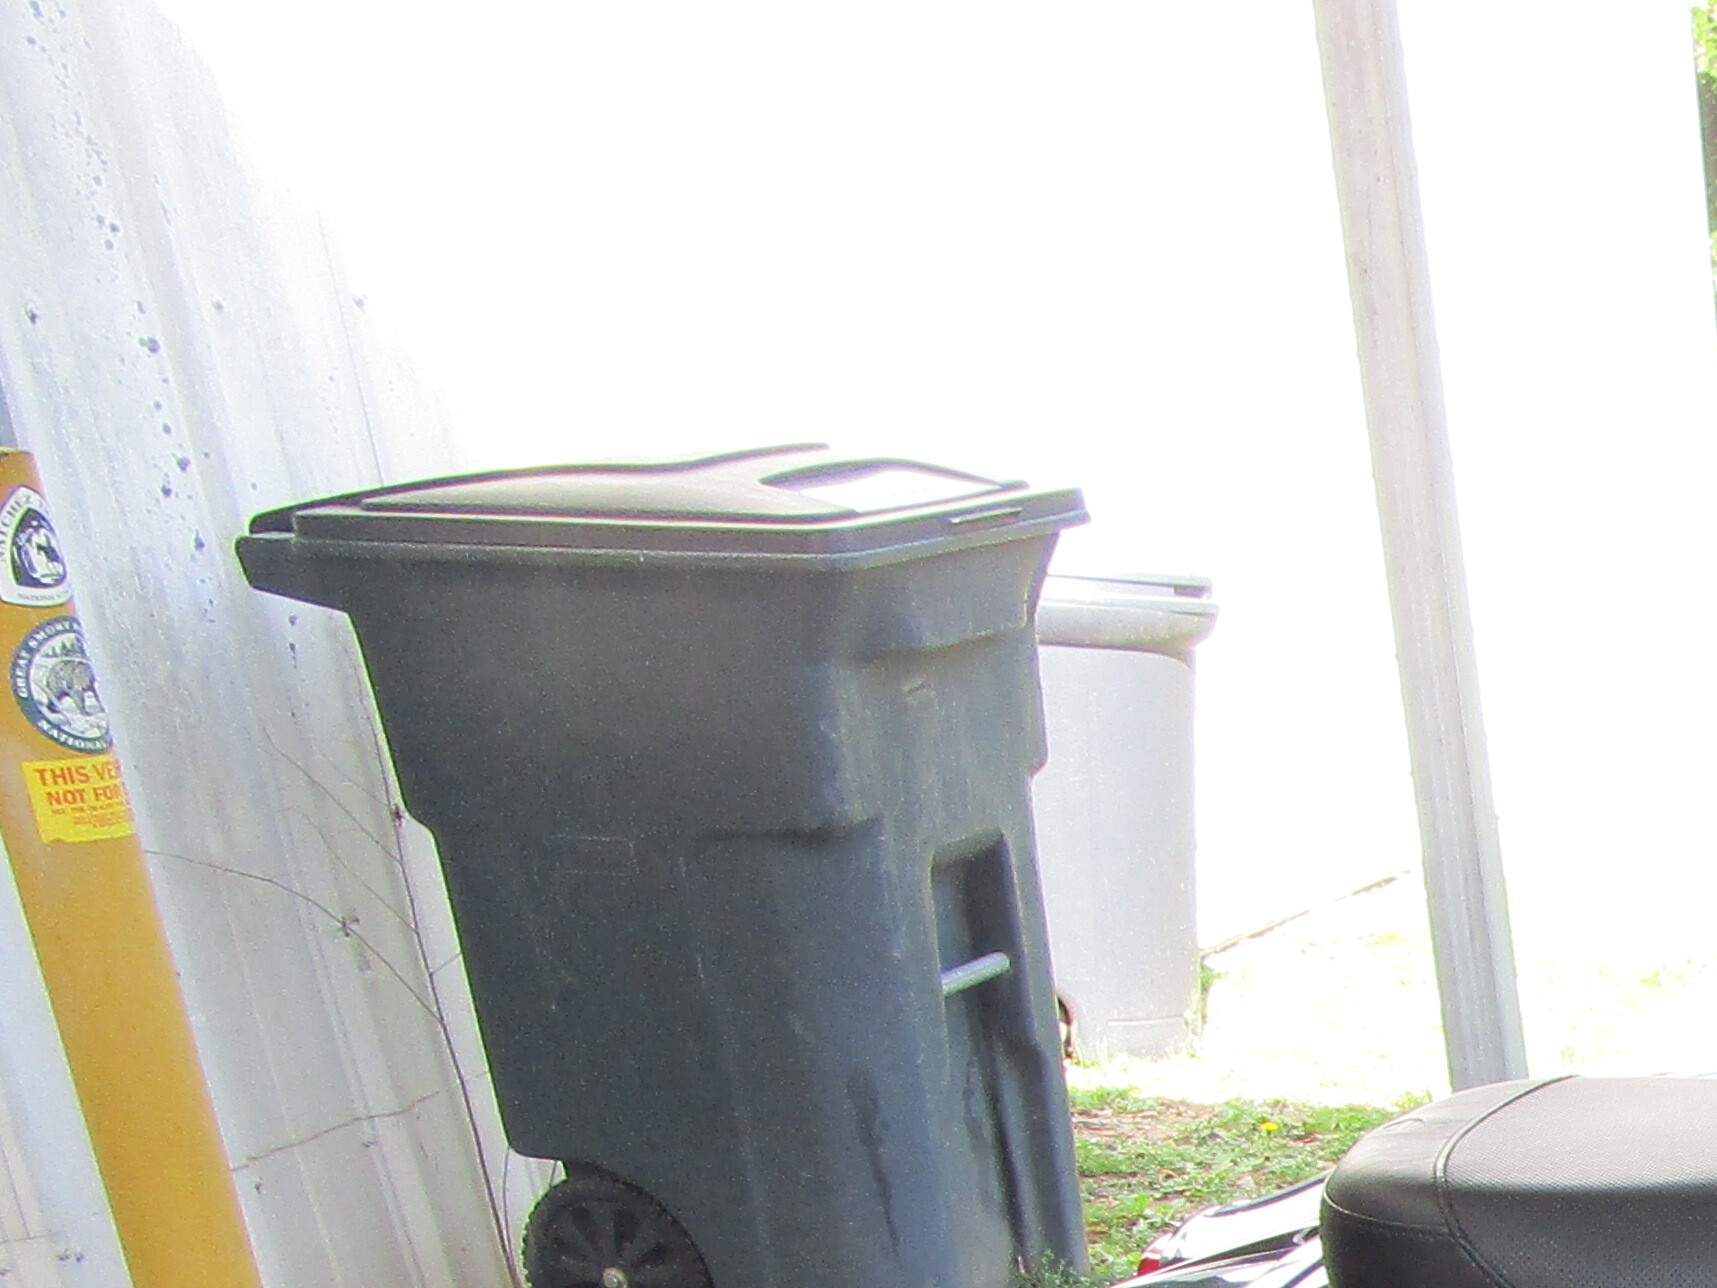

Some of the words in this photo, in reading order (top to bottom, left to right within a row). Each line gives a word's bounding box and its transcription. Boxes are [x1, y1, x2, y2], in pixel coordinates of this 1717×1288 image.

[15, 649, 31, 699] GREAT
[33, 765, 91, 787] THIS
[46, 788, 86, 806] NOT
